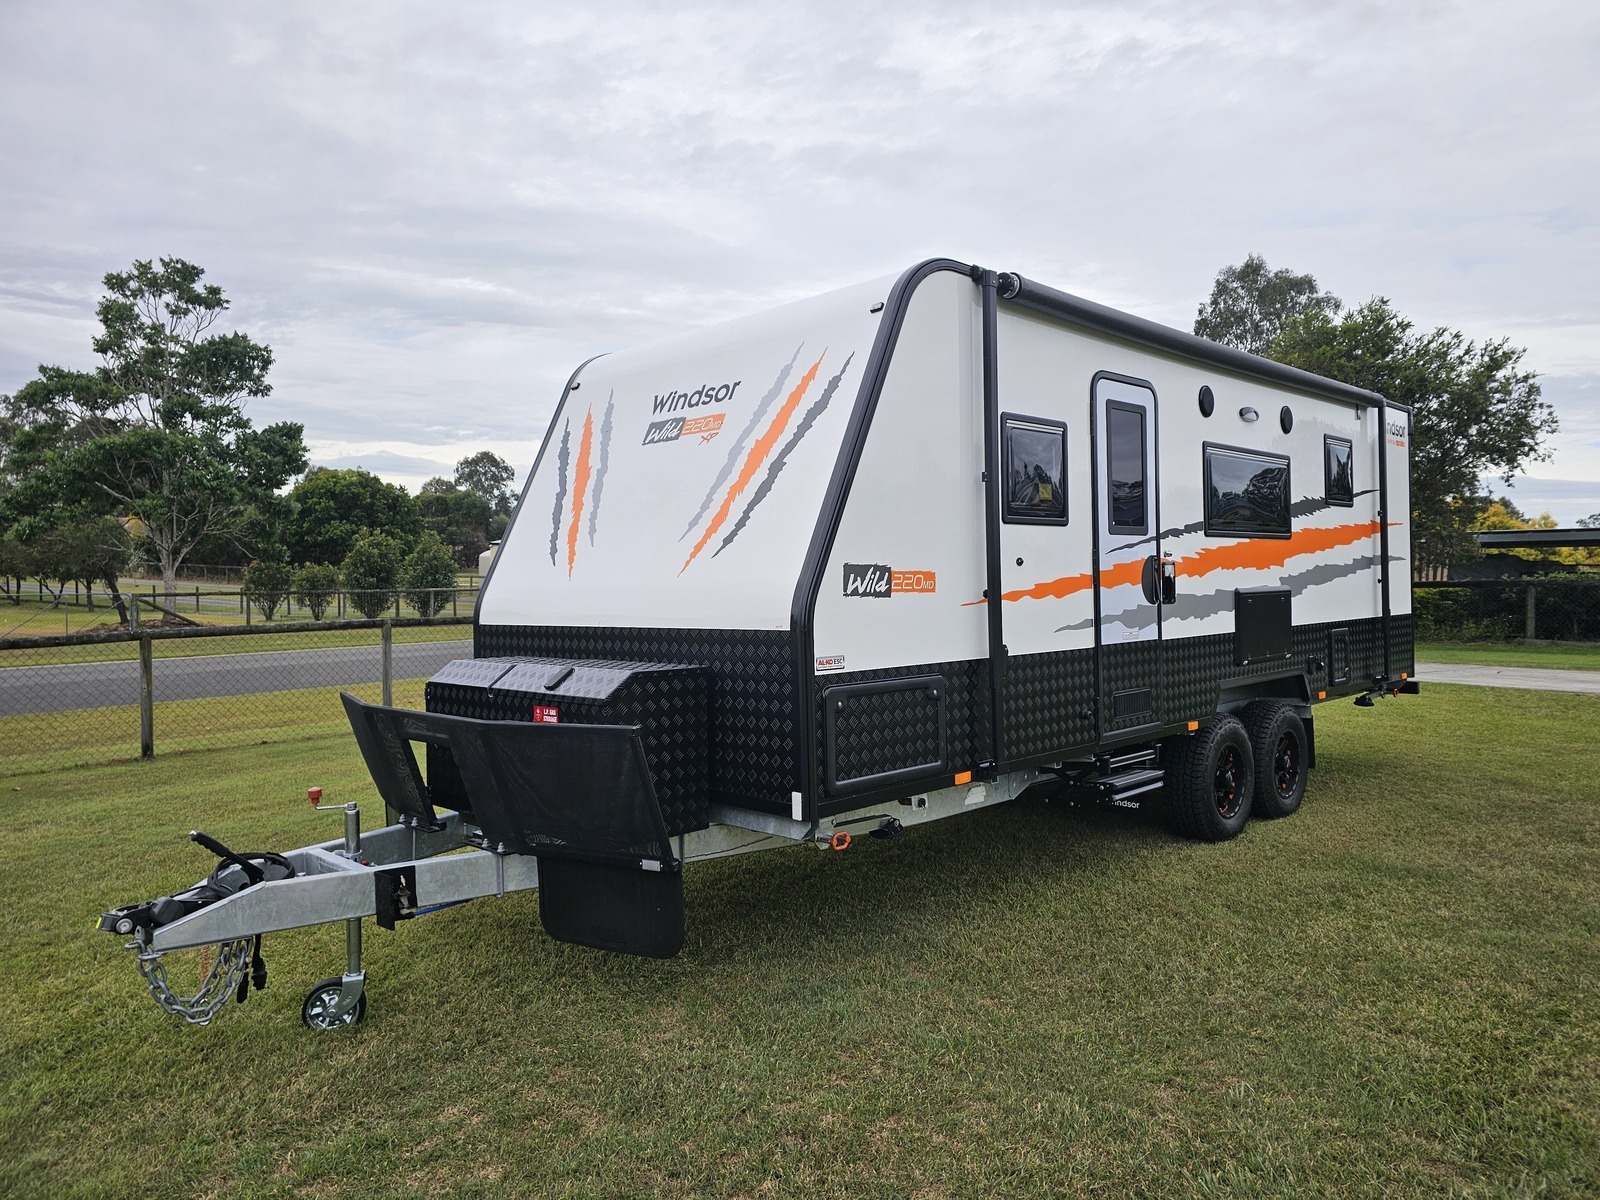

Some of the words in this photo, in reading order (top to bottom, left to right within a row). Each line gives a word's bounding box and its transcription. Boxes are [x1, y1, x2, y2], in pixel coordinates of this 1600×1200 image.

[652, 380, 742, 416] Windsor
[645, 419, 683, 443] Wild
[847, 566, 890, 595] Wild
[1110, 799, 1140, 809] indsor
